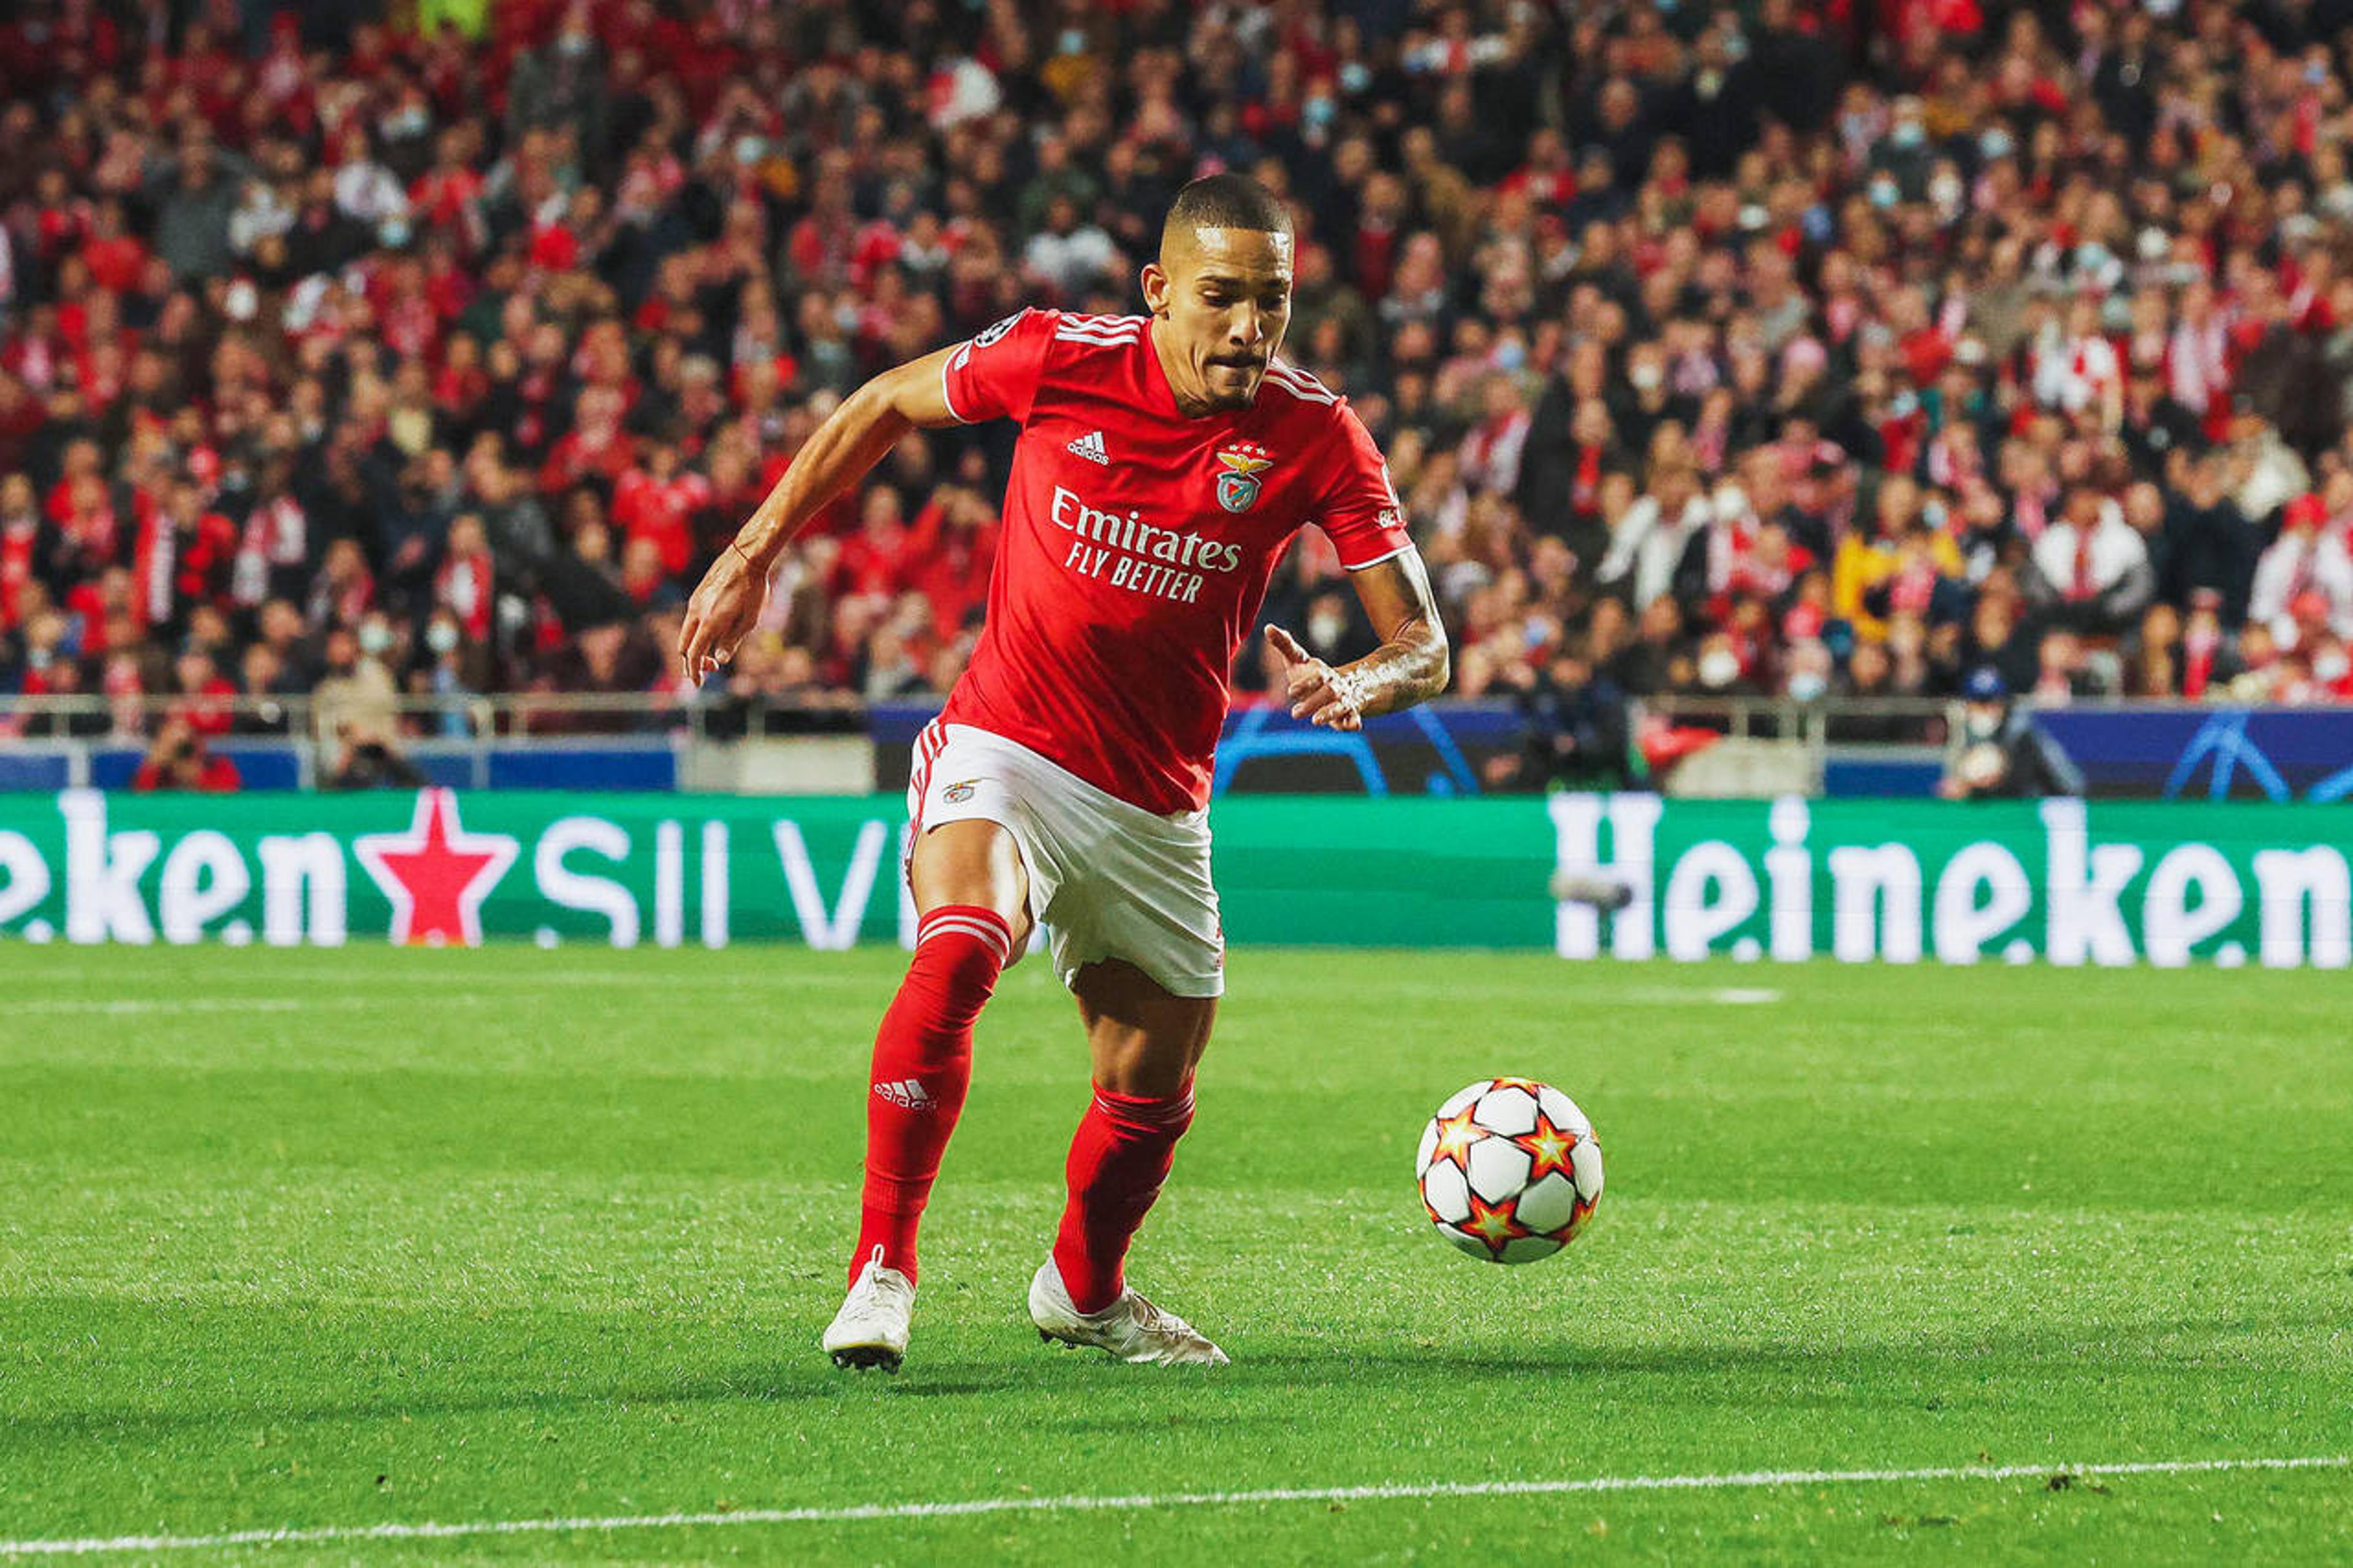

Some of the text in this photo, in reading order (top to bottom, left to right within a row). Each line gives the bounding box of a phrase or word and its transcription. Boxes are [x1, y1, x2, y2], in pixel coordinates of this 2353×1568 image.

[1067, 442, 1109, 466] adidas
[1050, 485, 1241, 573] Emirates
[1065, 541, 1203, 604] FLY BETTER
[1547, 790, 2352, 968] Heineken
